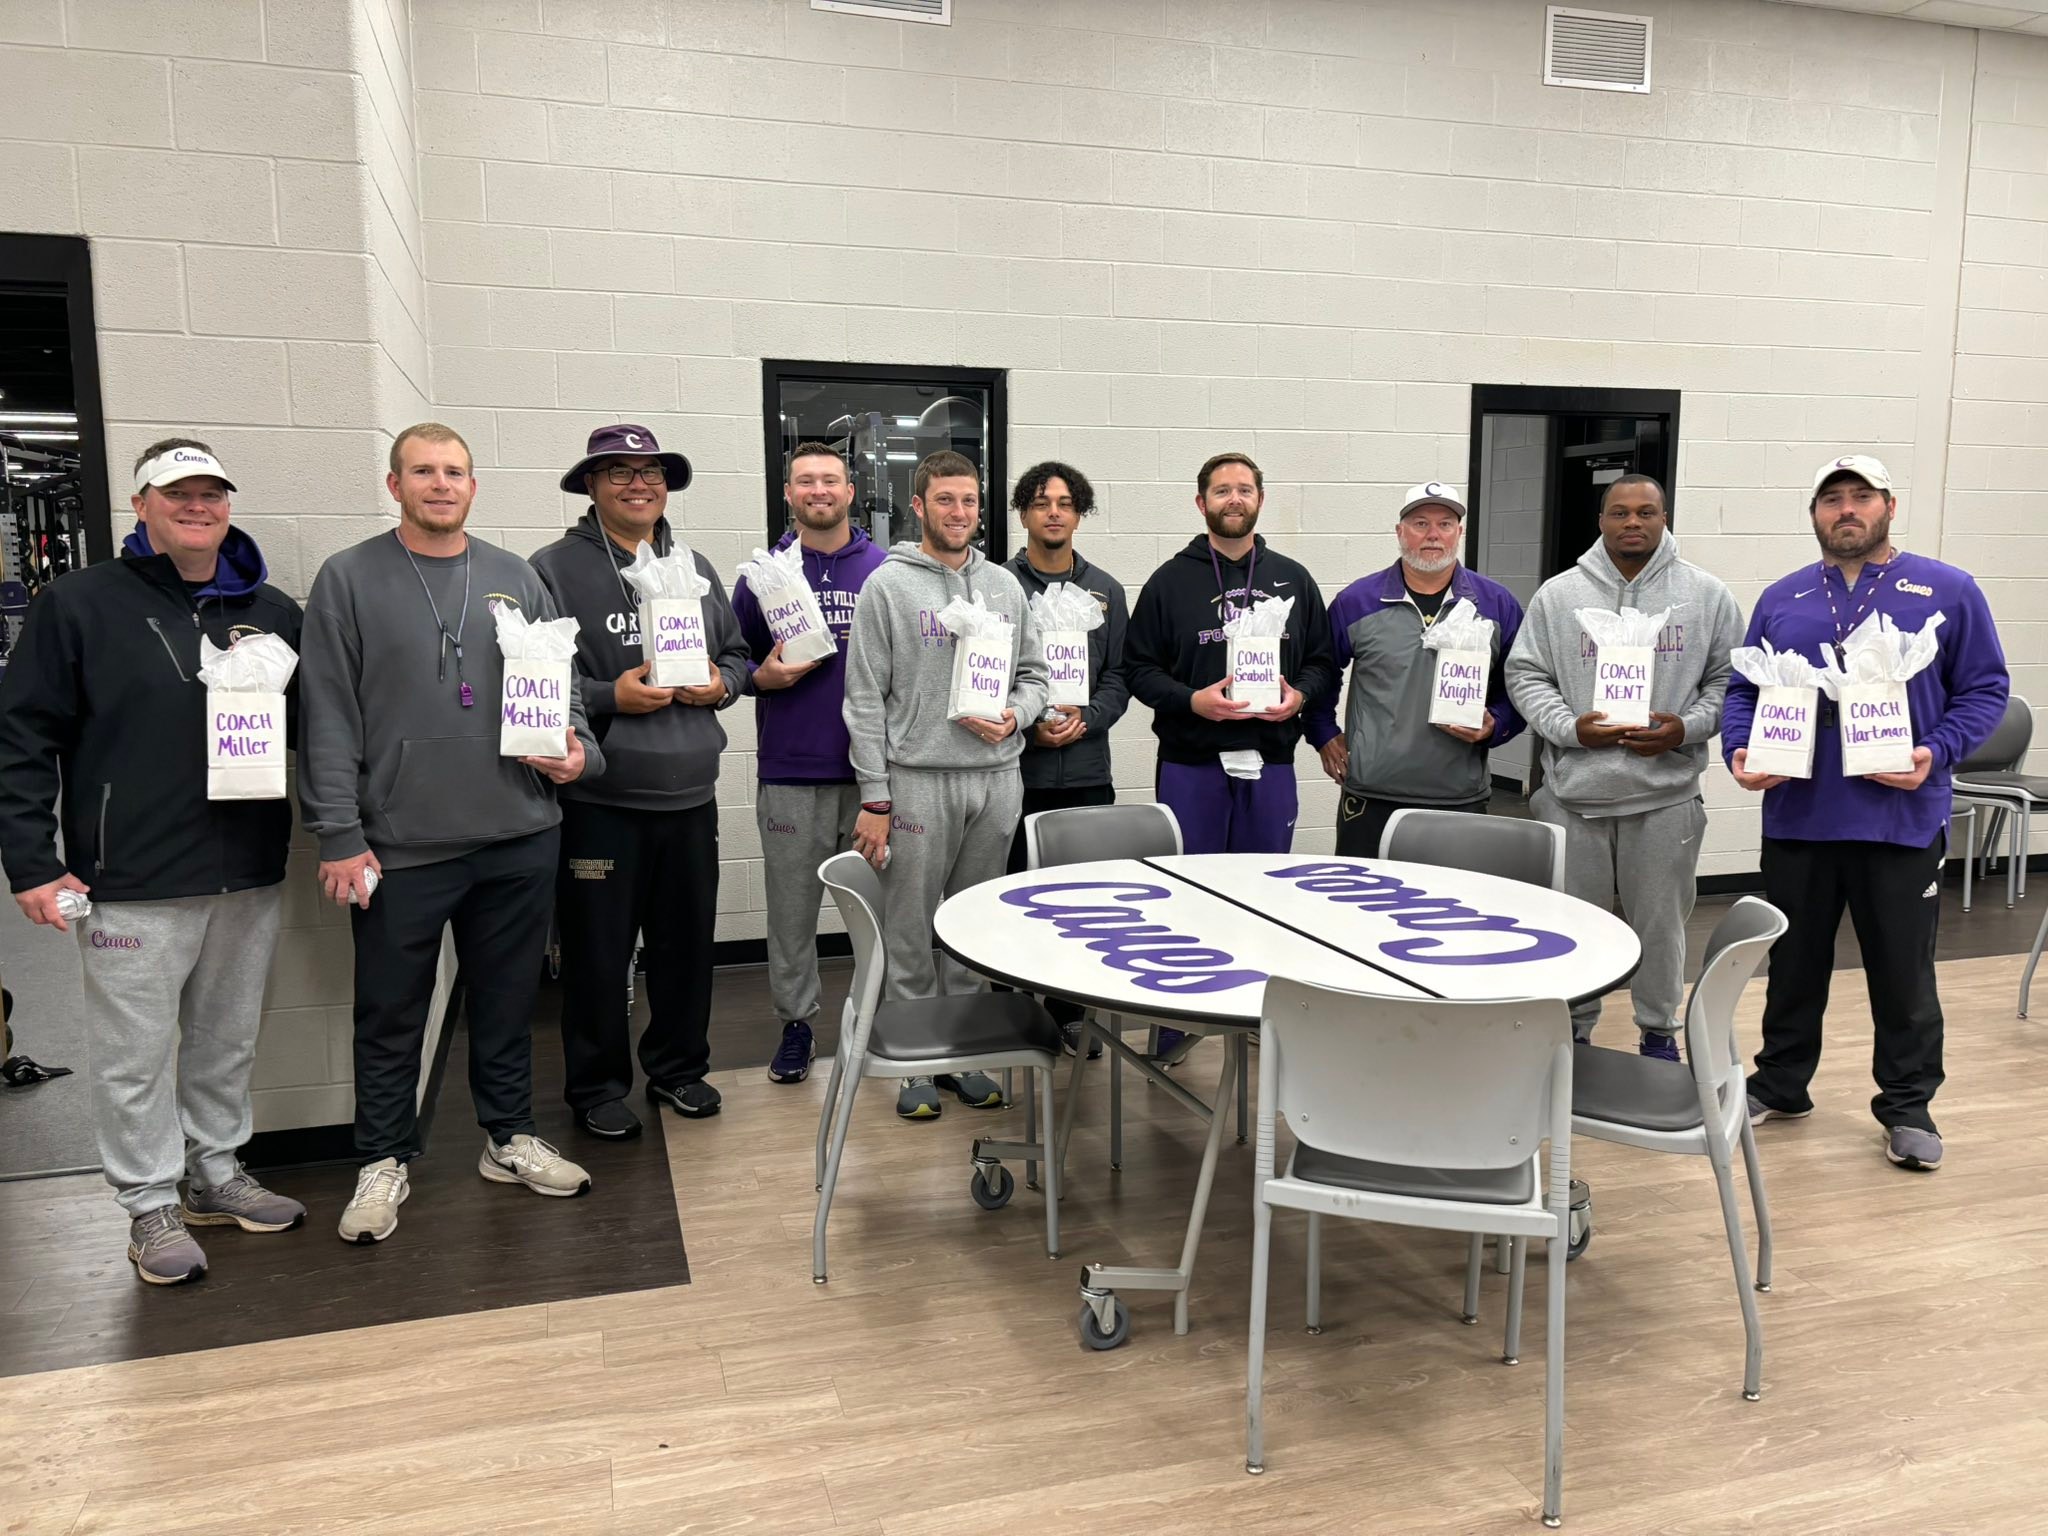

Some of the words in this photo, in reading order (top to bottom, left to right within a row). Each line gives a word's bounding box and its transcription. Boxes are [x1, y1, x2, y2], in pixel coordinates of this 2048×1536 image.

[625, 433, 643, 449] C
[174, 451, 209, 465] Canes
[1425, 482, 1442, 497] C
[1895, 578, 1933, 597] Canes
[766, 600, 804, 625] COACH
[660, 616, 699, 631] COACH
[656, 633, 704, 653] Candela
[1046, 644, 1086, 661] COACH
[968, 652, 1006, 672] COACH
[1237, 650, 1275, 666] COACH
[1234, 668, 1275, 683] Seabolt
[1441, 661, 1481, 680] COACH
[1600, 663, 1646, 680] COACH
[506, 675, 560, 700] COACH
[971, 671, 1000, 698] King
[1439, 679, 1483, 706] Knight
[1605, 684, 1645, 700] KENT
[502, 702, 562, 728] Mathis
[1760, 704, 1806, 722] COACH
[1850, 701, 1901, 719] COACH
[216, 712, 273, 731] COACH
[1763, 725, 1802, 742] WARD
[1845, 723, 1910, 743] Hartman
[217, 735, 271, 757] Miller
[1344, 796, 1357, 815] C
[767, 817, 796, 834] Canes
[892, 815, 924, 834] Canes
[1264, 863, 1577, 965] Canes
[90, 929, 143, 950] Canes
[999, 882, 1269, 994] Canes
